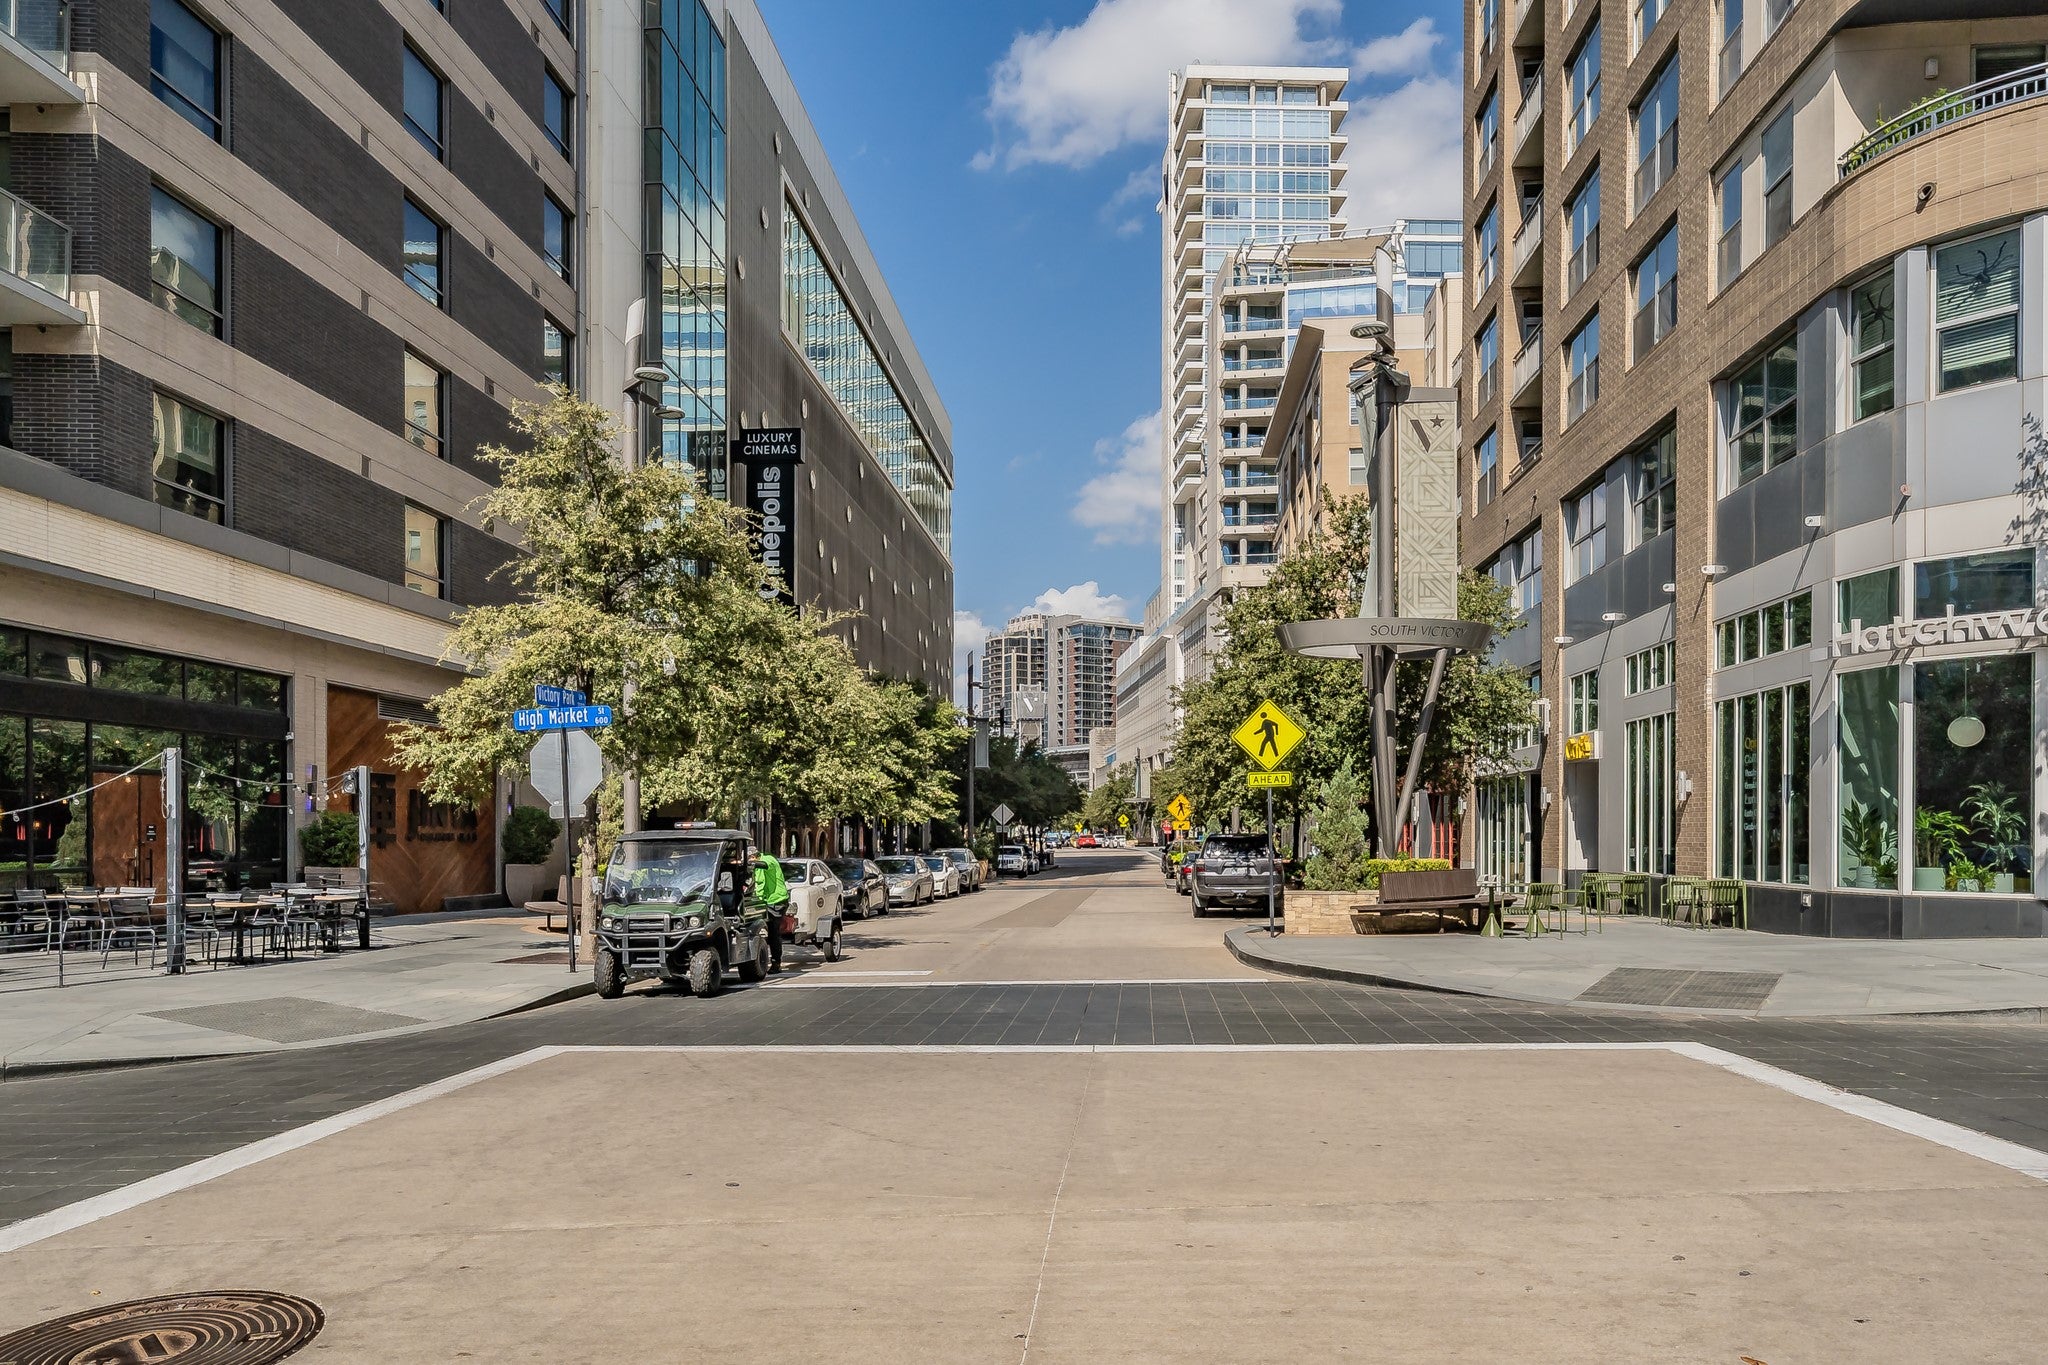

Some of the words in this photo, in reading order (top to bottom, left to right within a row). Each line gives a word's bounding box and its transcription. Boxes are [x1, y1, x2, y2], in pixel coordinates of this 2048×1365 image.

[747, 433, 793, 443] LUXURY
[743, 444, 797, 455] CINEMAS
[1370, 624, 1416, 636] SOUTH
[1420, 625, 1467, 638] VICTORY
[537, 685, 560, 707] Victory
[562, 690, 575, 706] Park
[518, 709, 543, 730] High
[549, 707, 588, 725] Market
[597, 707, 605, 715] St
[594, 716, 609, 725] 600
[1253, 774, 1287, 784] AHEAD
